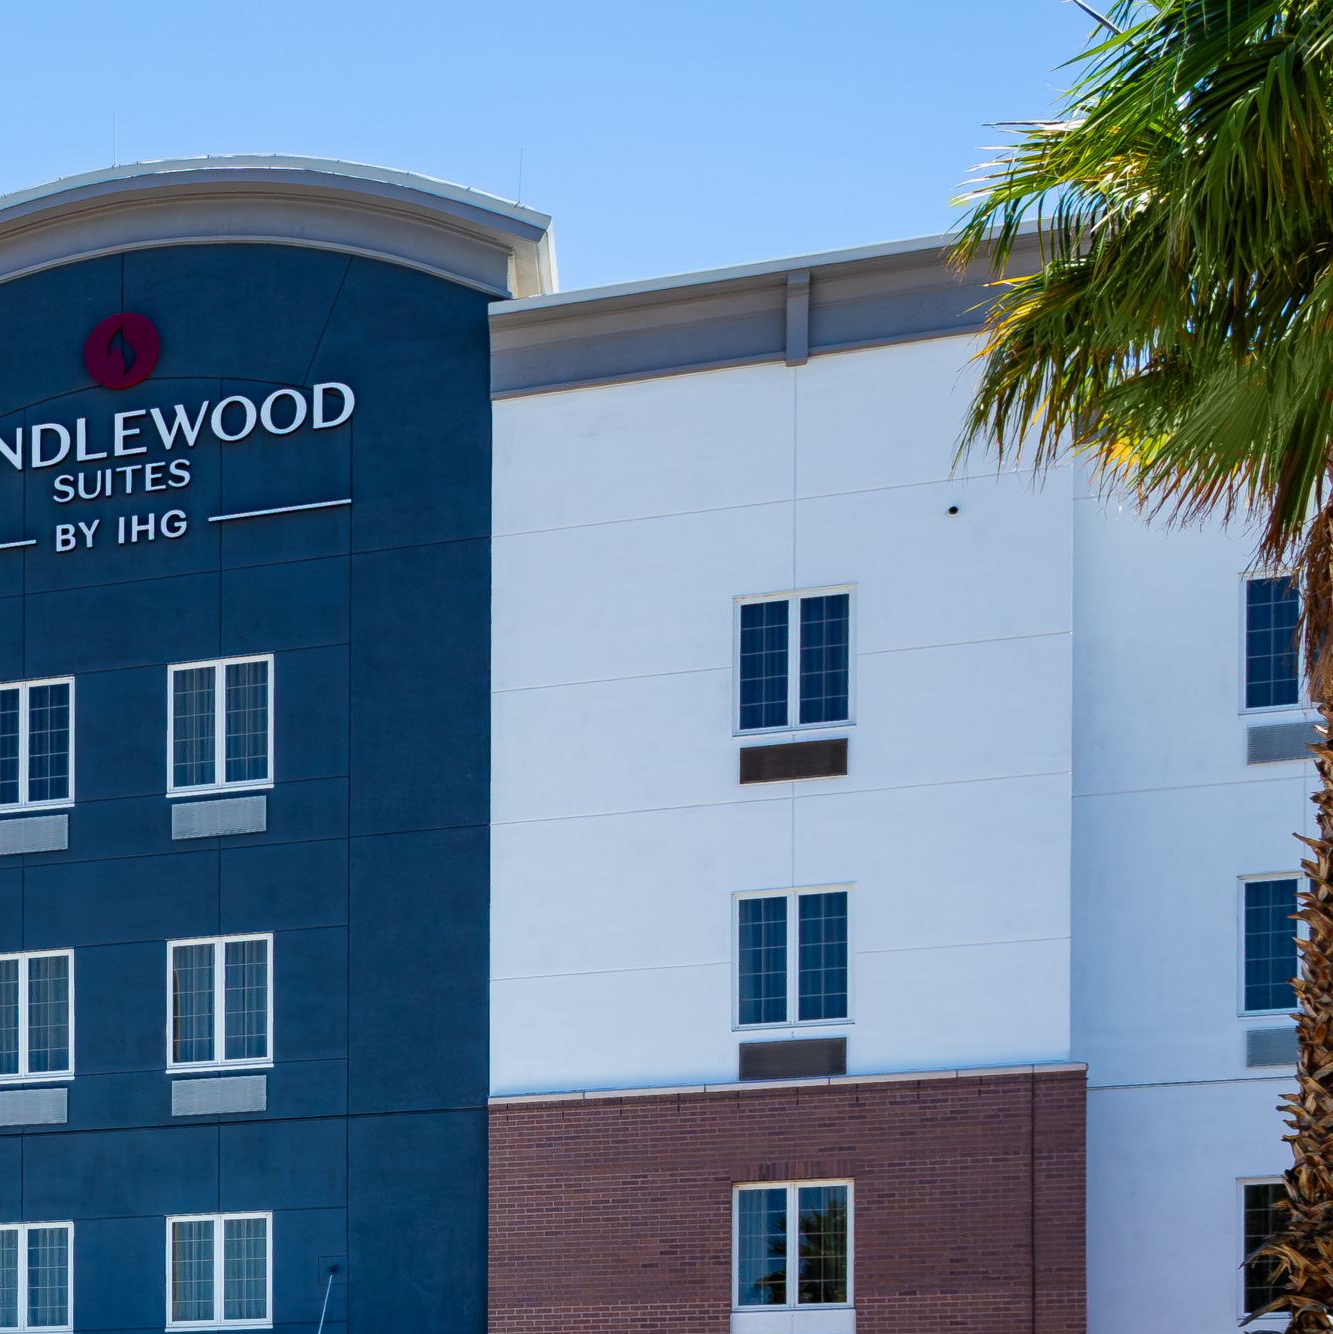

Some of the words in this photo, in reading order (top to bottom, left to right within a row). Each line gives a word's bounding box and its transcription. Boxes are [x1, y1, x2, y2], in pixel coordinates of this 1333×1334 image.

[53, 458, 191, 504] SUITES
[55, 519, 100, 553] BY
[118, 509, 188, 545] IHG
